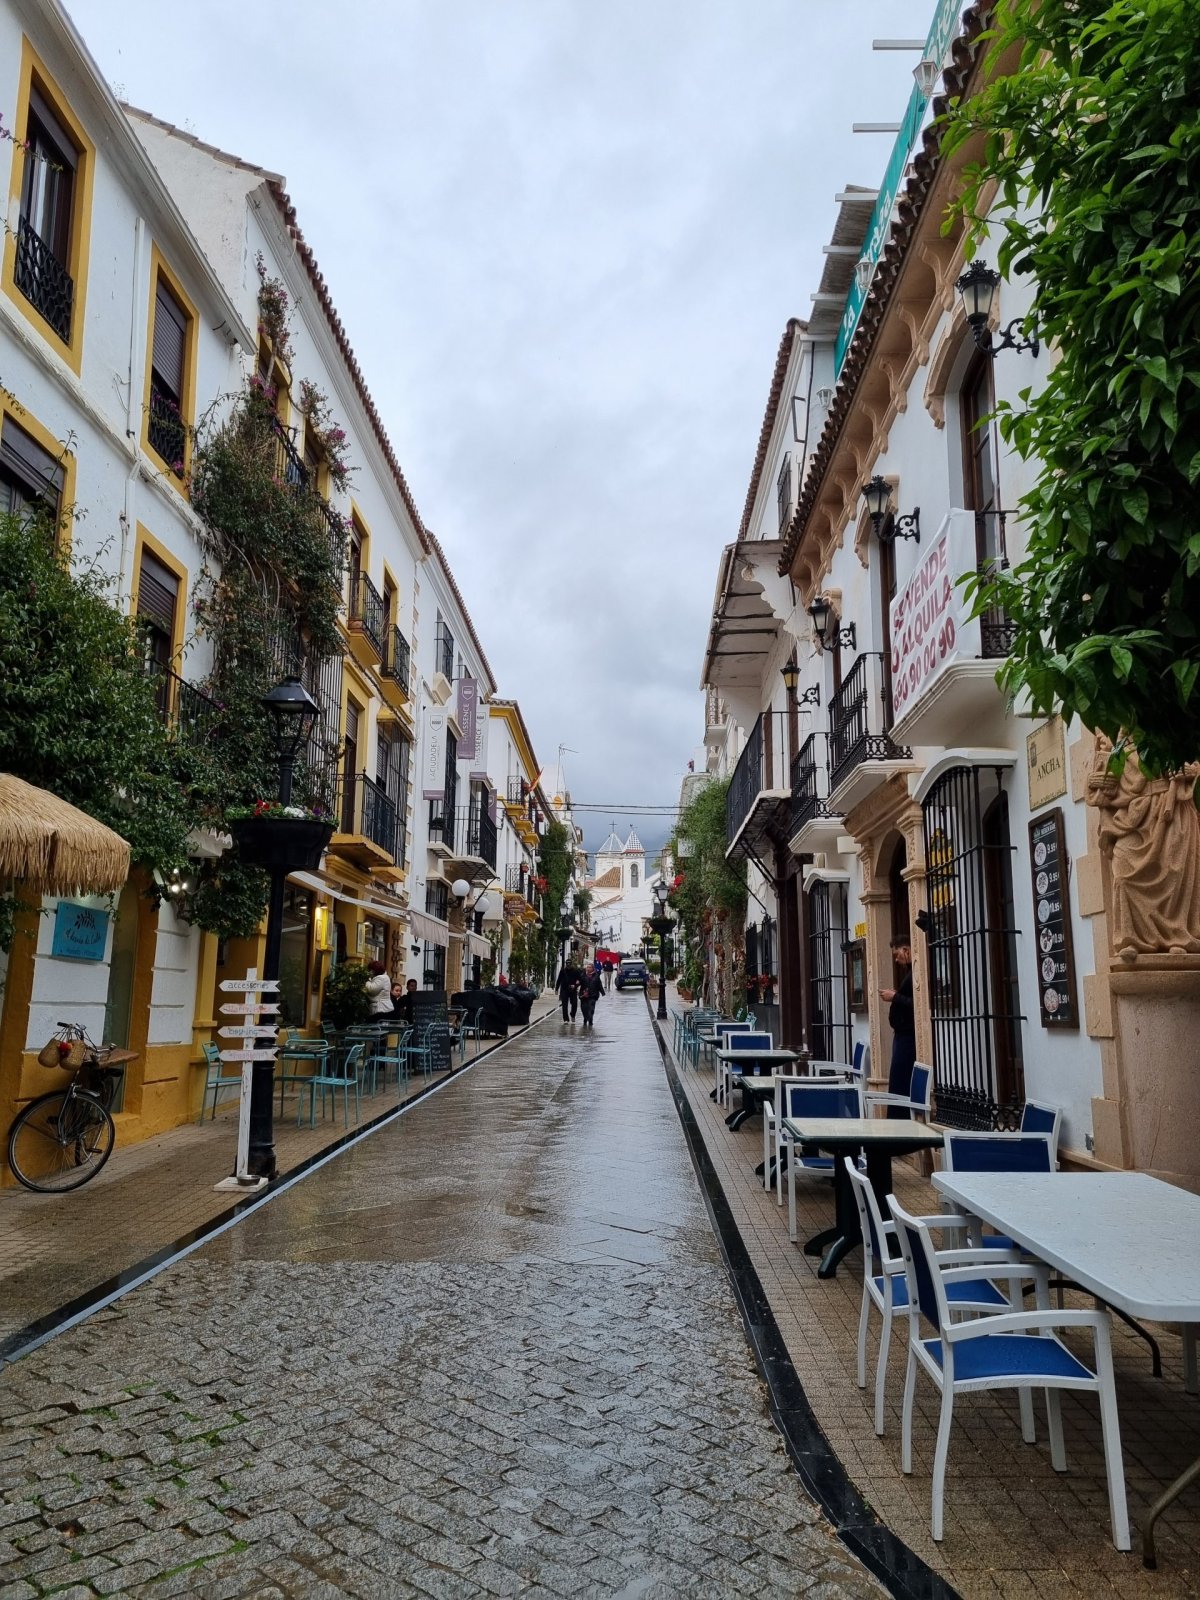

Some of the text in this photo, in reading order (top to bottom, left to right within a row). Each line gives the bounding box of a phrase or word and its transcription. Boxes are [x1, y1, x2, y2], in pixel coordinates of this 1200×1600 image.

[905, 536, 948, 606] VENDE
[902, 574, 952, 662] ALQUILA
[909, 656, 922, 693] 90
[923, 637, 936, 676] 00
[939, 616, 955, 659] 90
[1037, 756, 1061, 781] ANCHA
